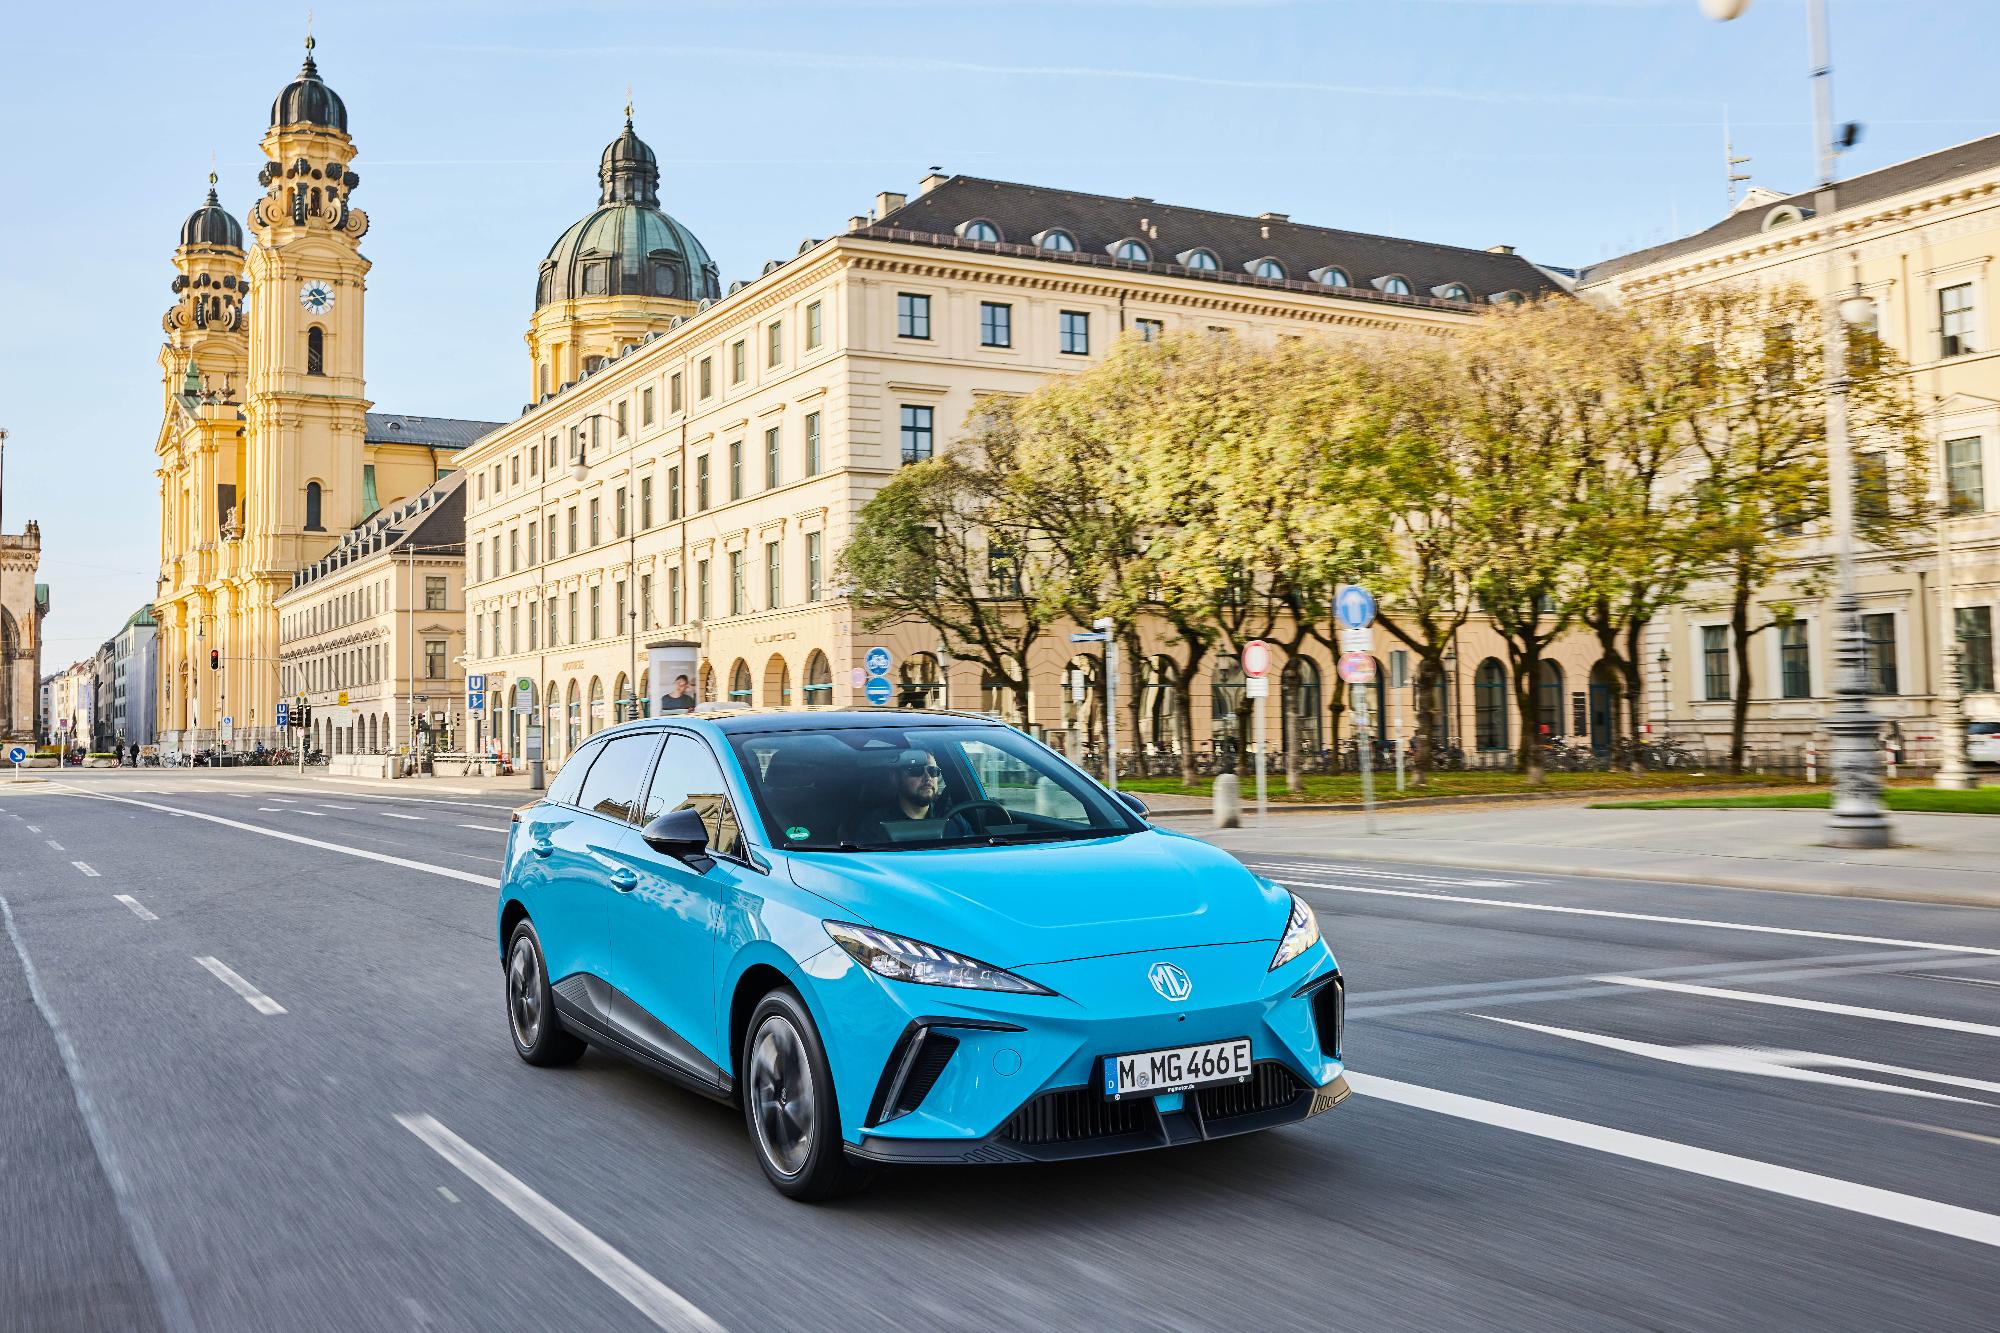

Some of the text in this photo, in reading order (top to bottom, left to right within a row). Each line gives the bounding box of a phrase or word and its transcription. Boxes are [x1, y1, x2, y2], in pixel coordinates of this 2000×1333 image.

[471, 677, 481, 690] U
[279, 704, 285, 713] U
[1151, 965, 1190, 998] MG
[1120, 1059, 1136, 1089] M
[1108, 1080, 1114, 1089] D
